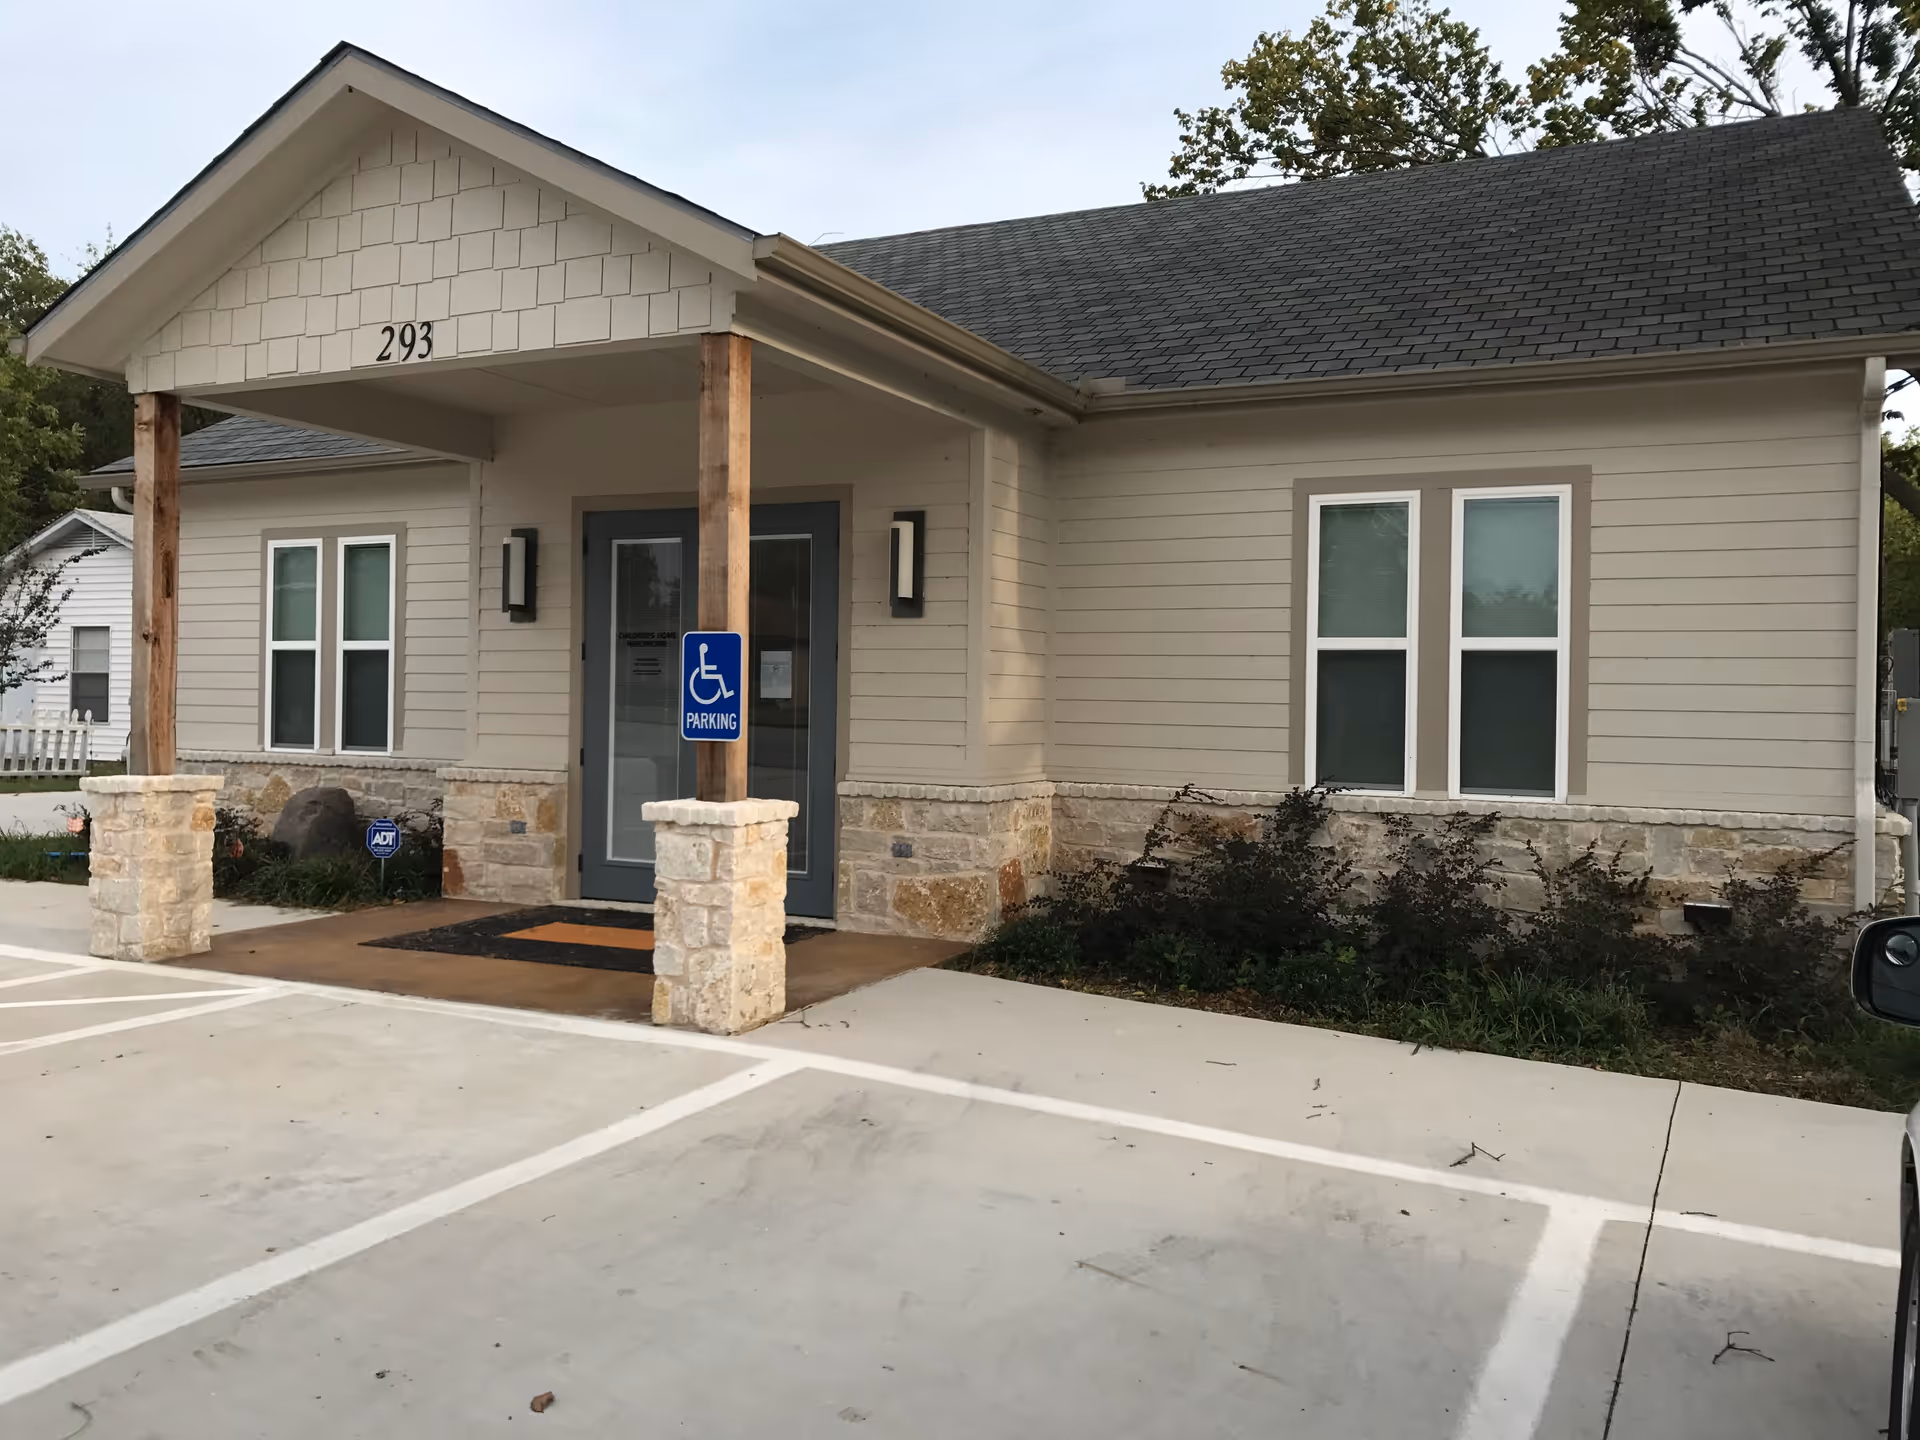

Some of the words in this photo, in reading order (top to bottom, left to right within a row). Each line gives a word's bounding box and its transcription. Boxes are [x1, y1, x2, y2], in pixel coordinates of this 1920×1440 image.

[376, 321, 432, 362] 293
[686, 712, 737, 730] PARKING
[372, 831, 396, 846] ADT
